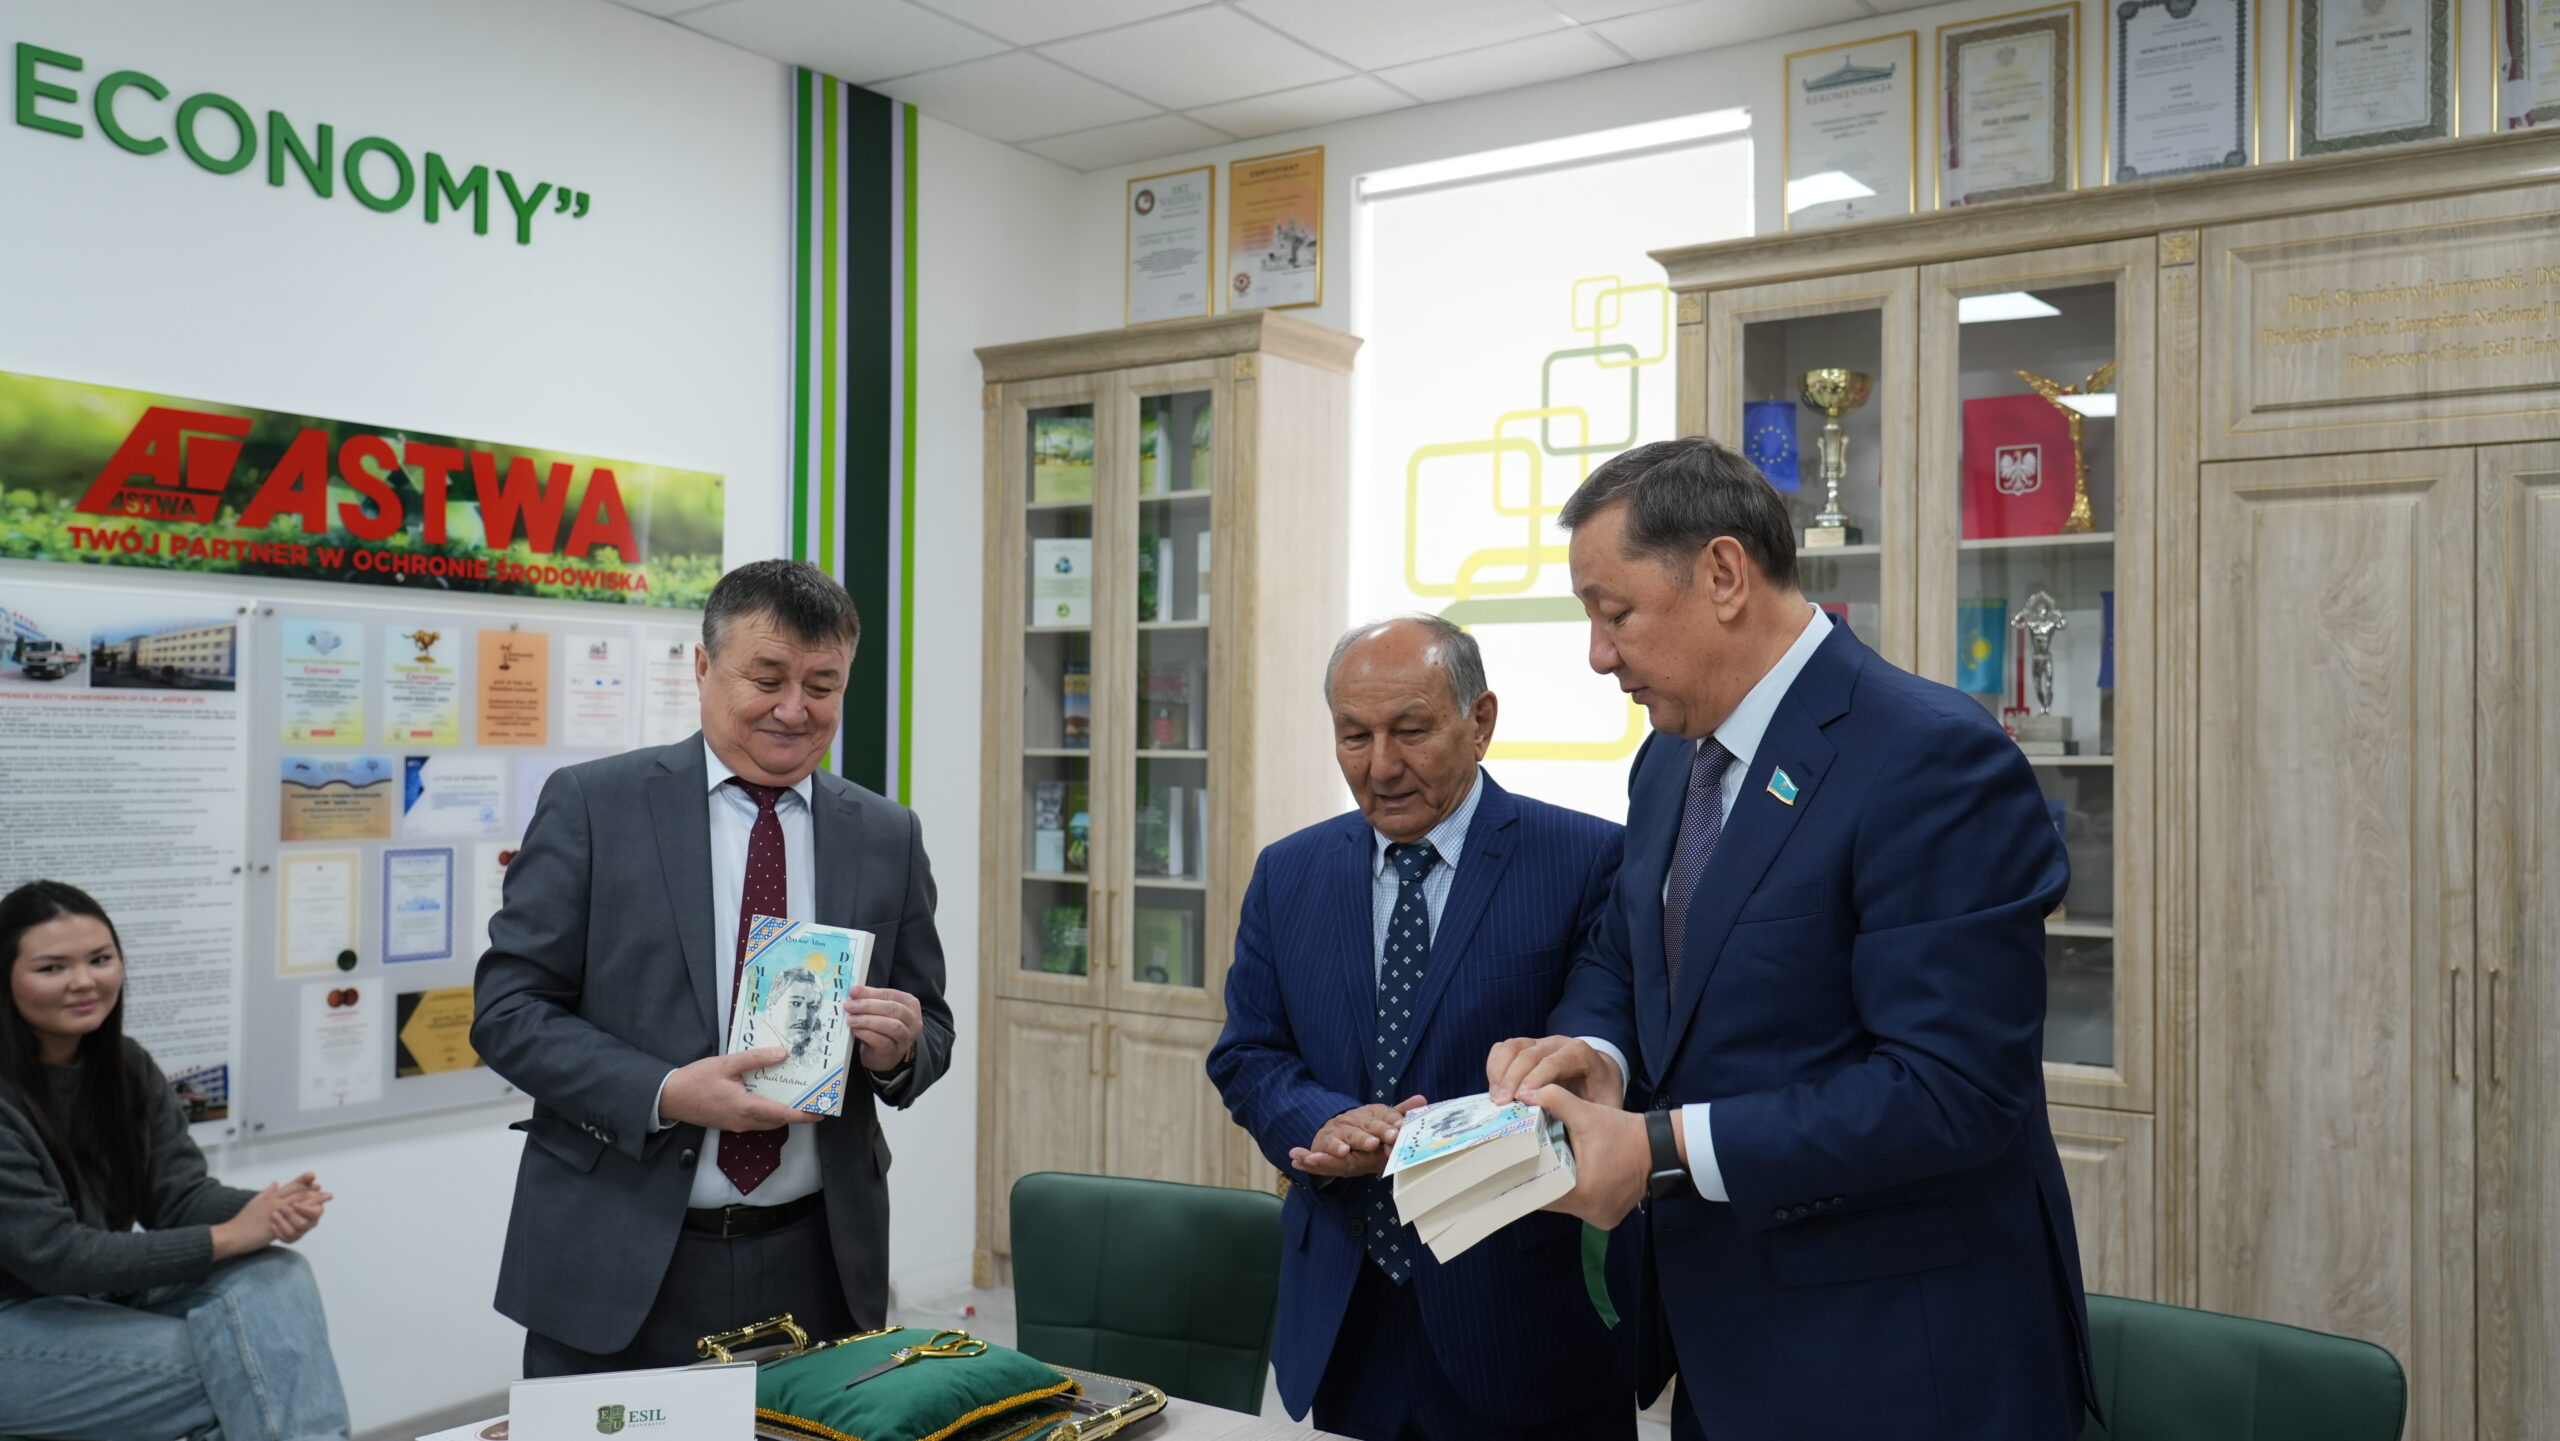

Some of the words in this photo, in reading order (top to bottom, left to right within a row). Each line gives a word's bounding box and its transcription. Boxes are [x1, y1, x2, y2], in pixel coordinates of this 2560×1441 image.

[2343, 318, 2362, 338] of
[2363, 317, 2389, 337] the
[105, 490, 199, 519] ASTWA
[234, 427, 642, 565] ASTWA
[67, 525, 160, 555] TWÓJ
[169, 533, 309, 567] PARTNER
[316, 546, 346, 569] W
[352, 549, 490, 580] OCHRONIE
[495, 556, 649, 593] ŚRODOWISKA
[629, 1408, 667, 1423] ESIL
